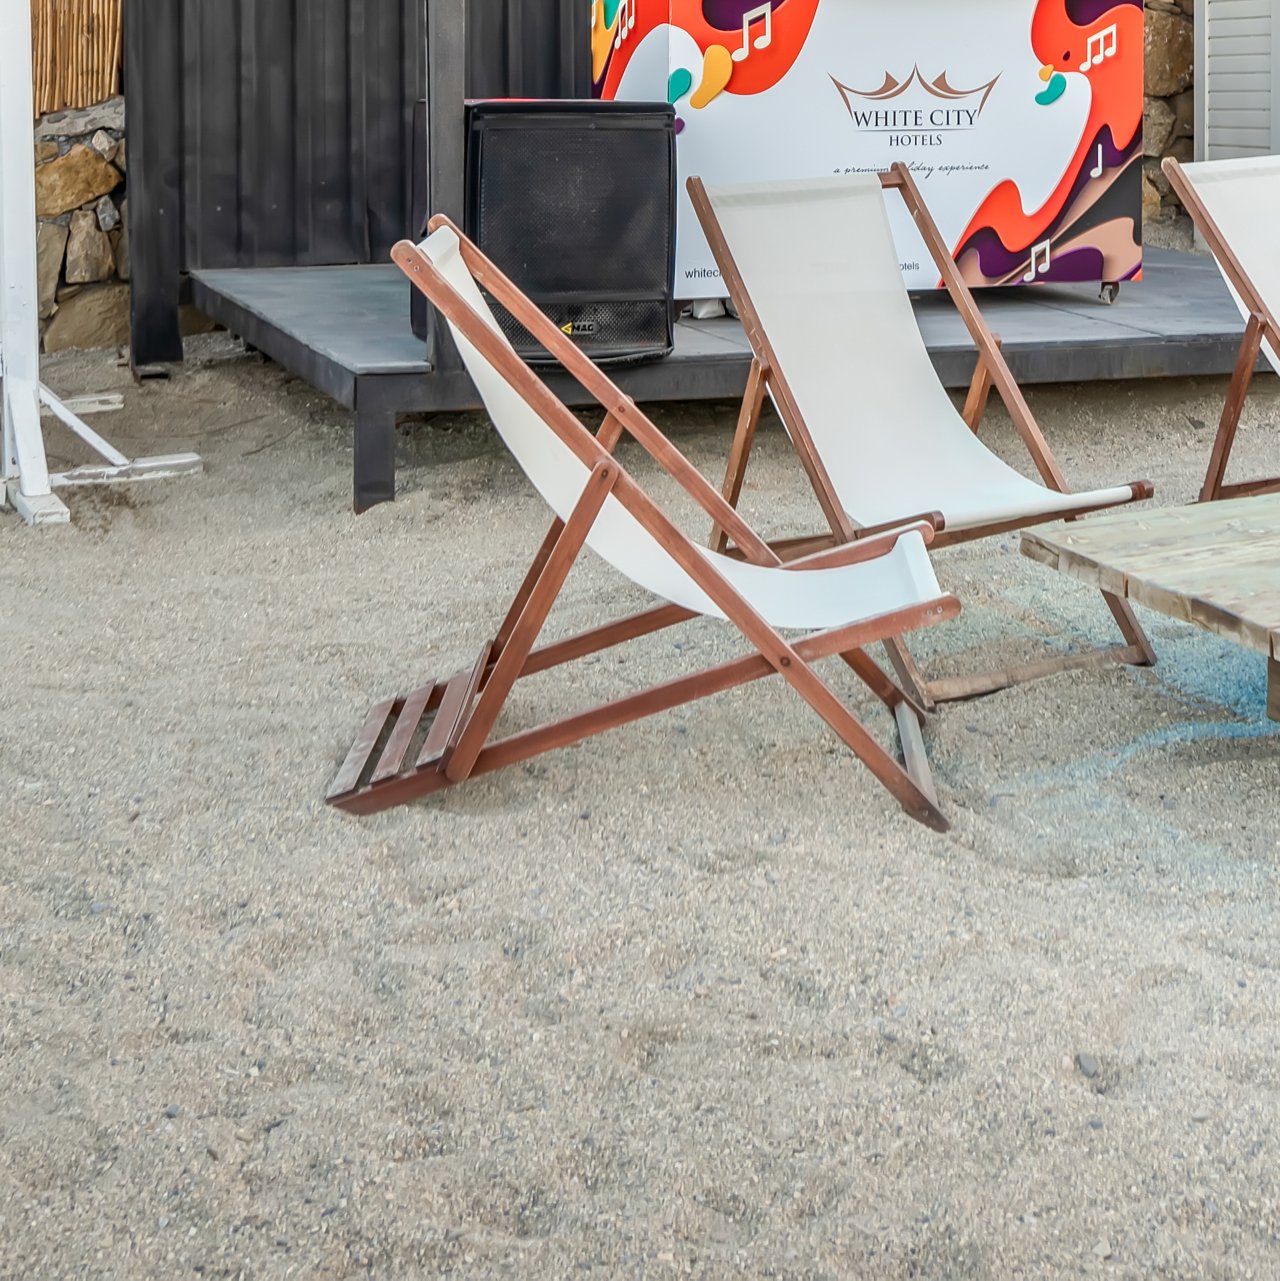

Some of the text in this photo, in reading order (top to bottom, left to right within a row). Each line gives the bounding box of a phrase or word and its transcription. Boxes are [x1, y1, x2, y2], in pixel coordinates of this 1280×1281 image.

[853, 109, 978, 127] WHITE CITY
[889, 134, 943, 147] HOTELS
[844, 163, 889, 174] premium
[938, 162, 989, 176] experience
